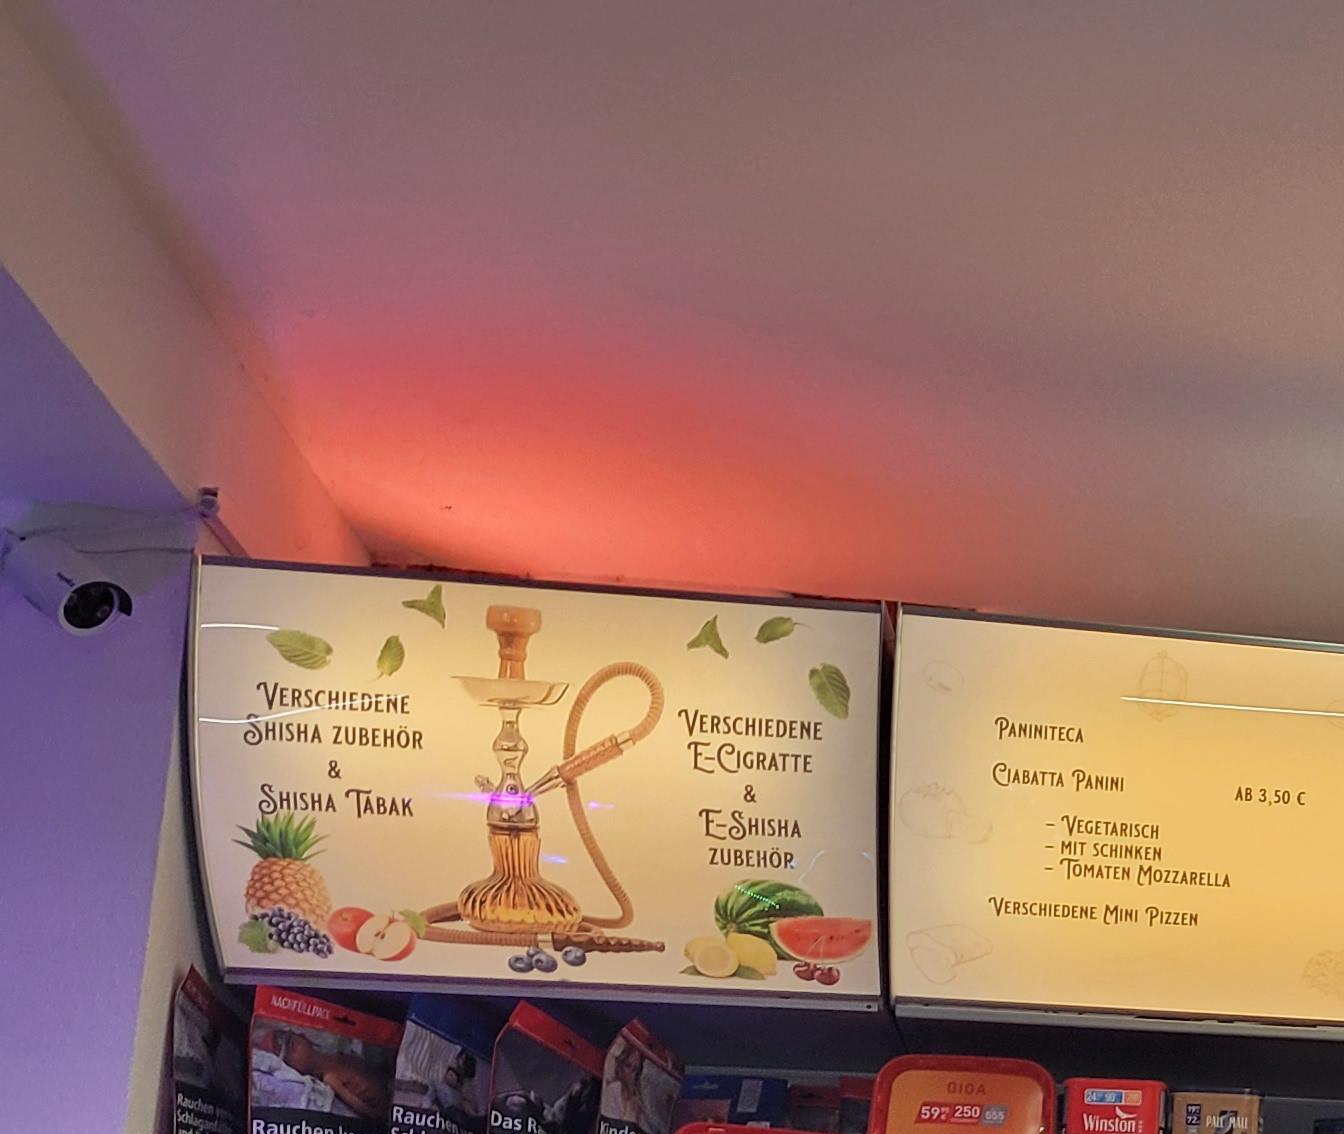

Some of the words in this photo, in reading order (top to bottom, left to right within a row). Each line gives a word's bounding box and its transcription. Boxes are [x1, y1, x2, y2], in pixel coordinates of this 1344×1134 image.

[327, 759, 342, 780] &
[743, 784, 757, 803] &
[1234, 786, 1253, 802] AB
[1258, 788, 1291, 807] 3,50
[946, 1081, 986, 1096] GIGA
[392, 1106, 459, 1134] Rauchen
[490, 1110, 523, 1132] Das
[954, 1104, 981, 1119] 250
[1083, 1113, 1136, 1134] Winston
